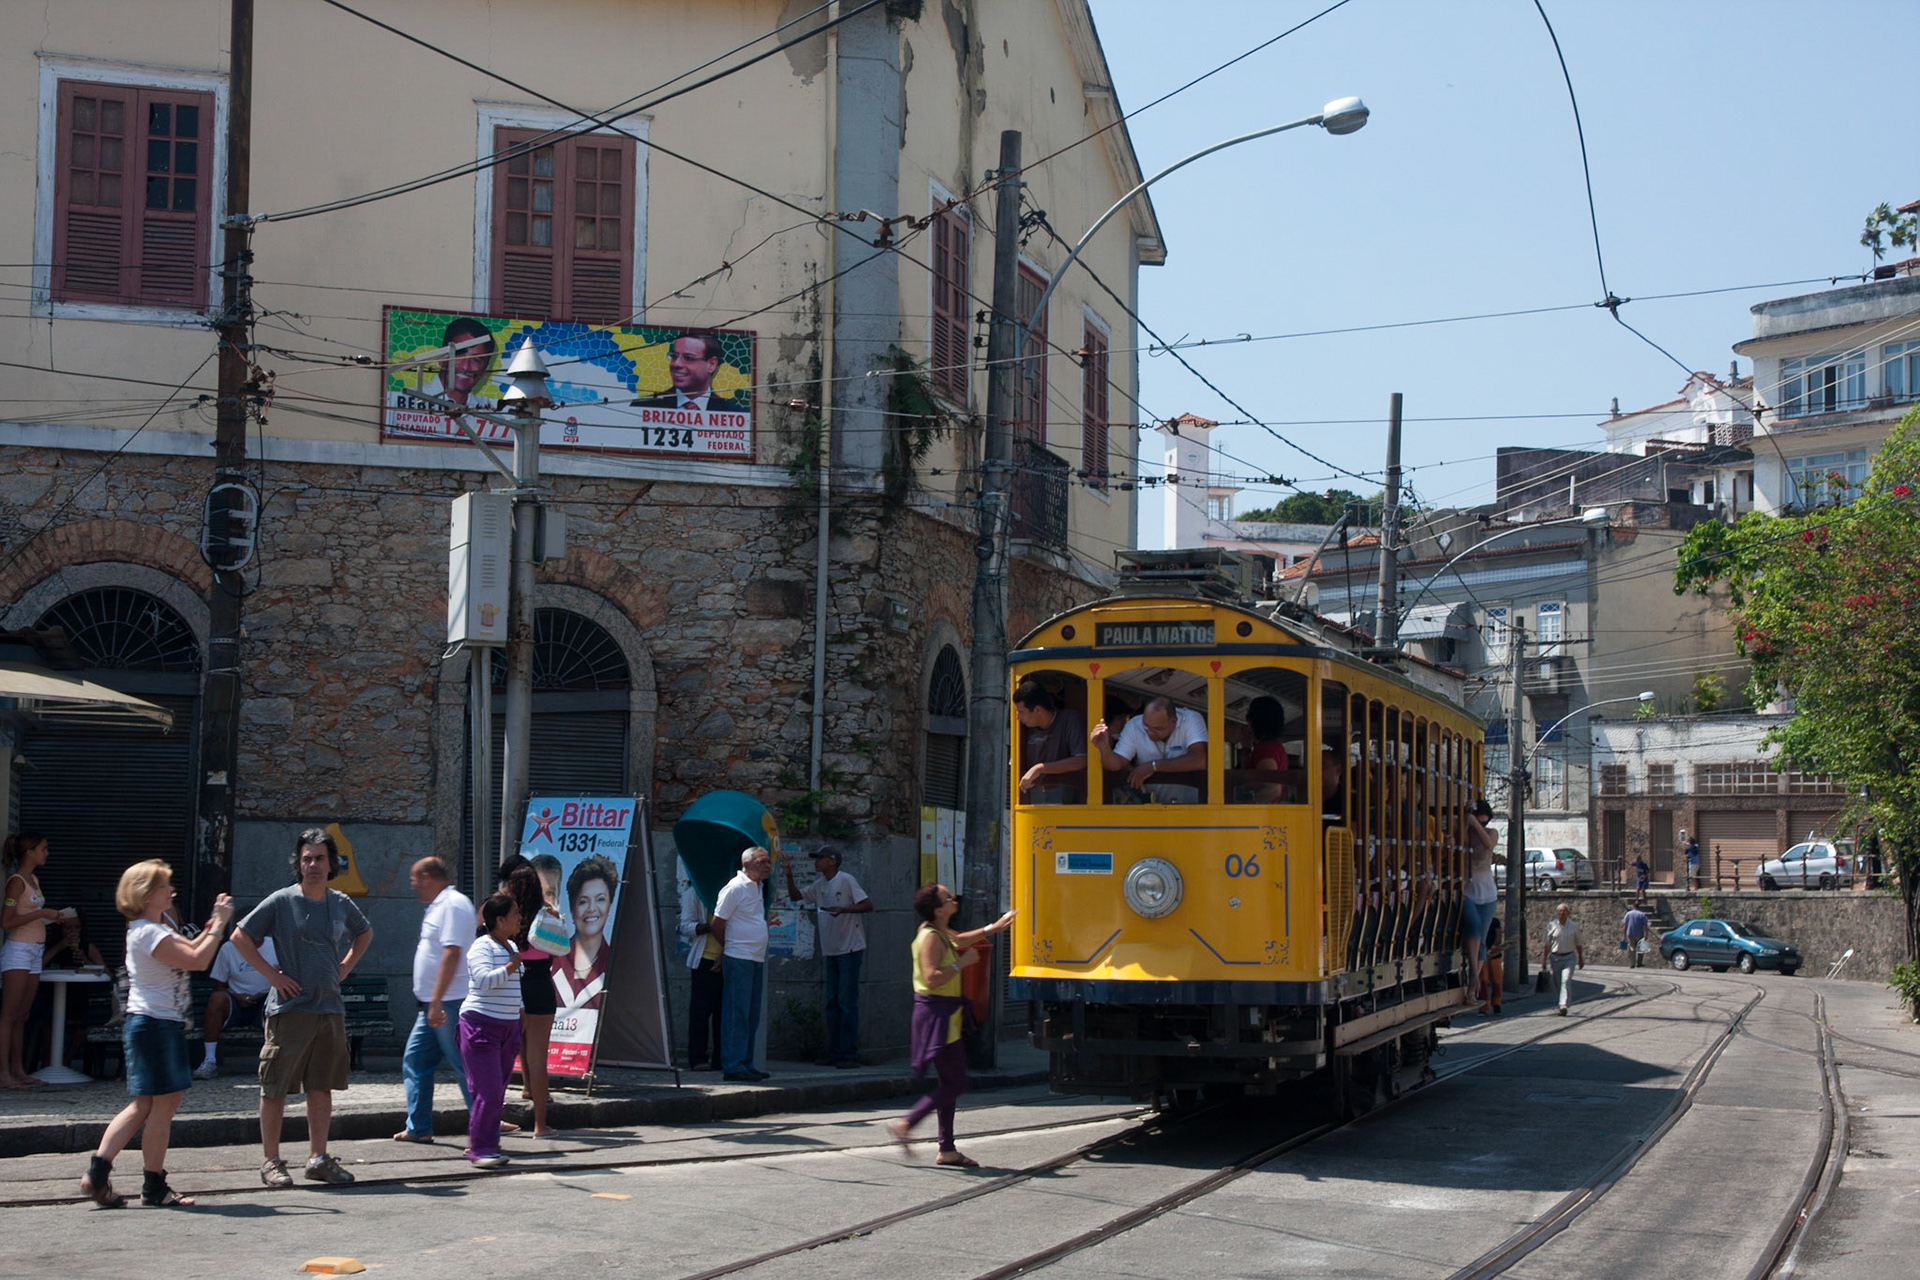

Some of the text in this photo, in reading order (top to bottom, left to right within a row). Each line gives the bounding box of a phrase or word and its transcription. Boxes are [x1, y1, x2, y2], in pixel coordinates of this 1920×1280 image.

[396, 413, 441, 424] DEPUTADO
[642, 409, 745, 427] BRIZOLA NETO
[396, 424, 437, 434] ESTADUAL
[641, 426, 693, 448] 1234
[697, 430, 745, 440] DEPUTADO
[707, 441, 745, 451] FEDERAL
[1103, 626, 1215, 645] PAULA MATTOS
[561, 802, 630, 827] Bittar
[558, 833, 597, 852] 1331
[597, 839, 625, 847] Federal
[1225, 853, 1260, 878] 06
